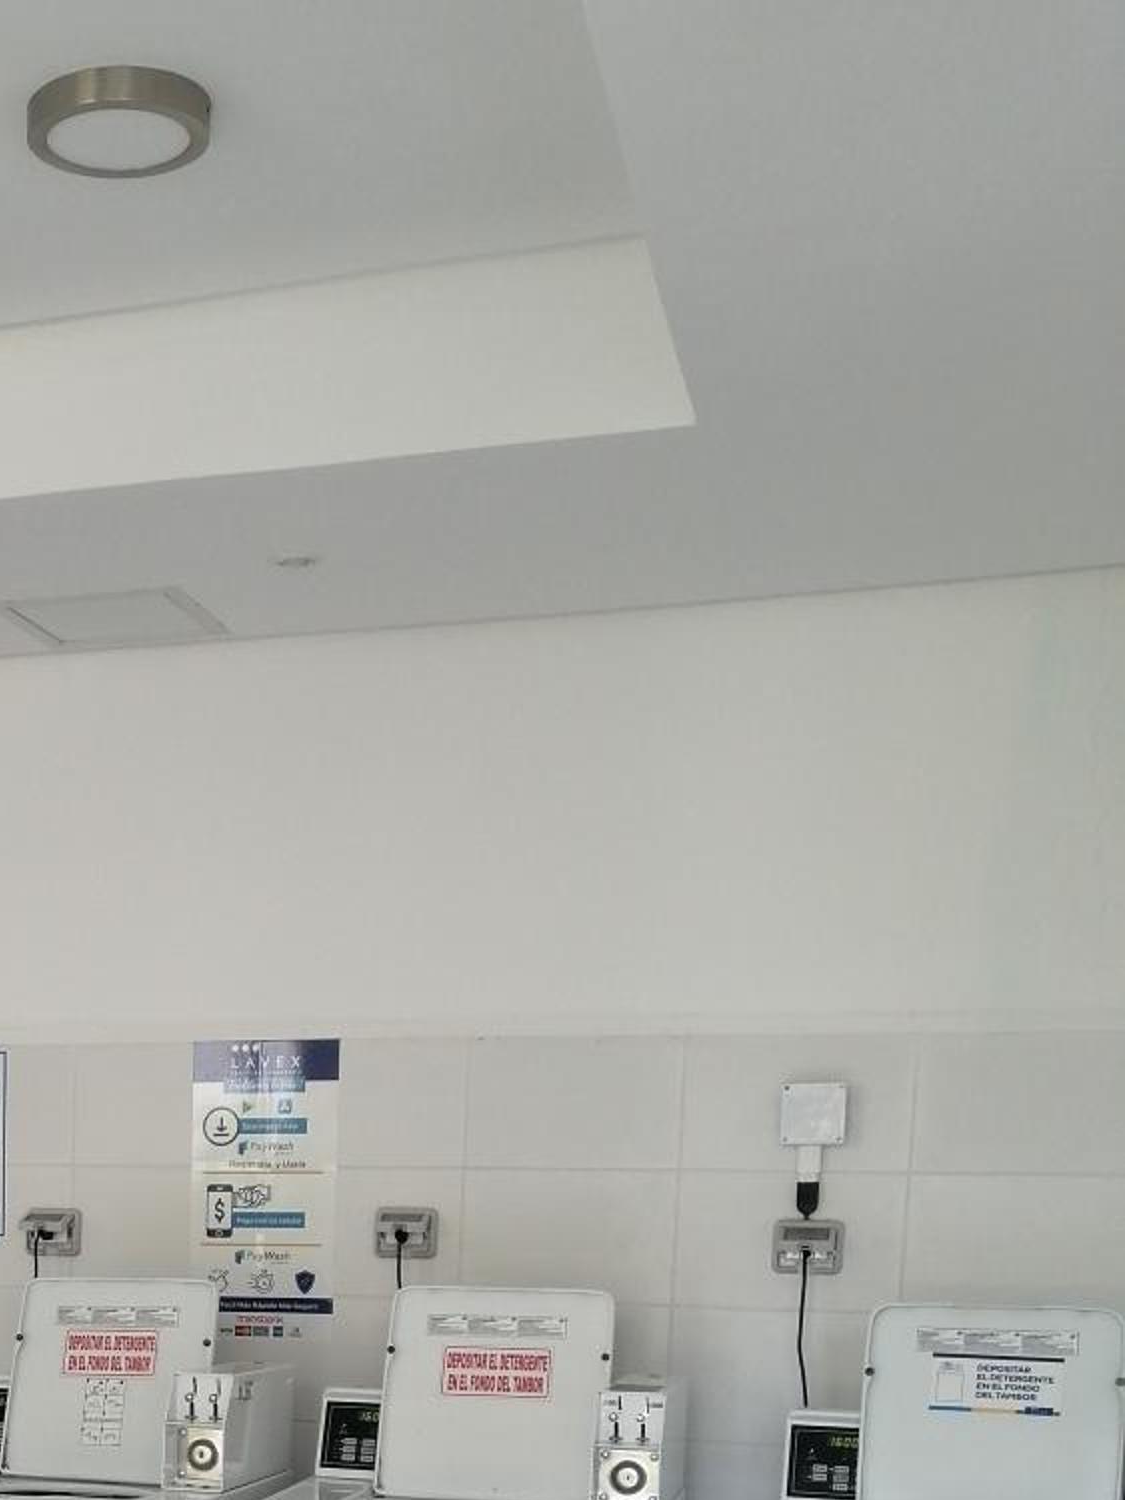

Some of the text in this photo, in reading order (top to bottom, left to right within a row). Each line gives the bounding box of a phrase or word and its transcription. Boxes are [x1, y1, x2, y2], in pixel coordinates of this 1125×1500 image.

[447, 1352, 548, 1372] DEPOSITAR EL DETERGENTE
[447, 1373, 457, 1391] EN
[459, 1374, 468, 1391] EL
[470, 1374, 495, 1392] FONDO
[497, 1375, 511, 1392] DEL
[990, 1374, 1055, 1385] DETERGENTE
